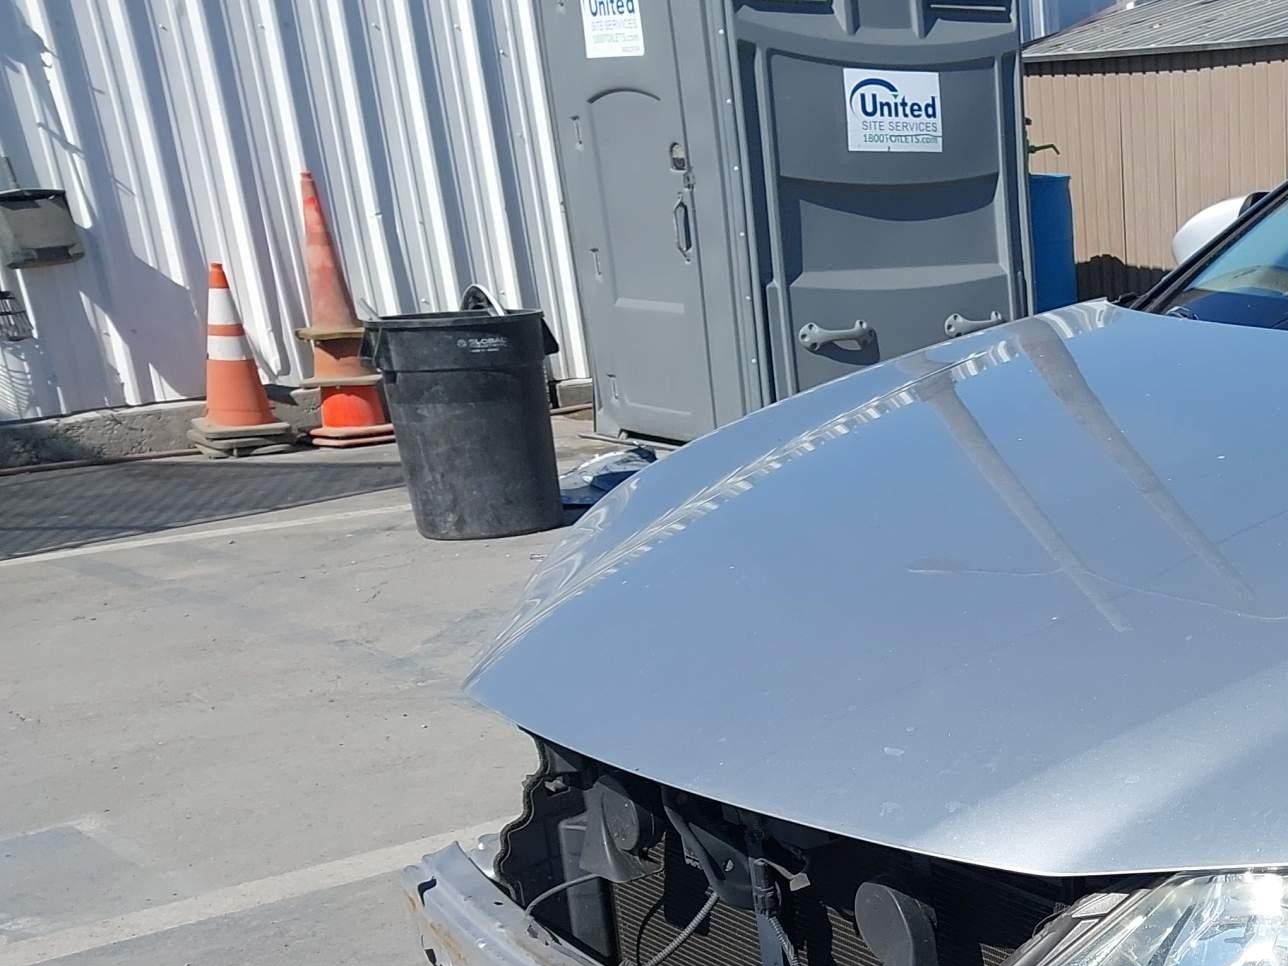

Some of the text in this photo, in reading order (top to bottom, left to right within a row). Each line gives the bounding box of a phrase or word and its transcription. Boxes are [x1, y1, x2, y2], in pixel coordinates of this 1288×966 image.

[860, 93, 937, 119] United
[862, 120, 938, 132] SITE SERVICES
